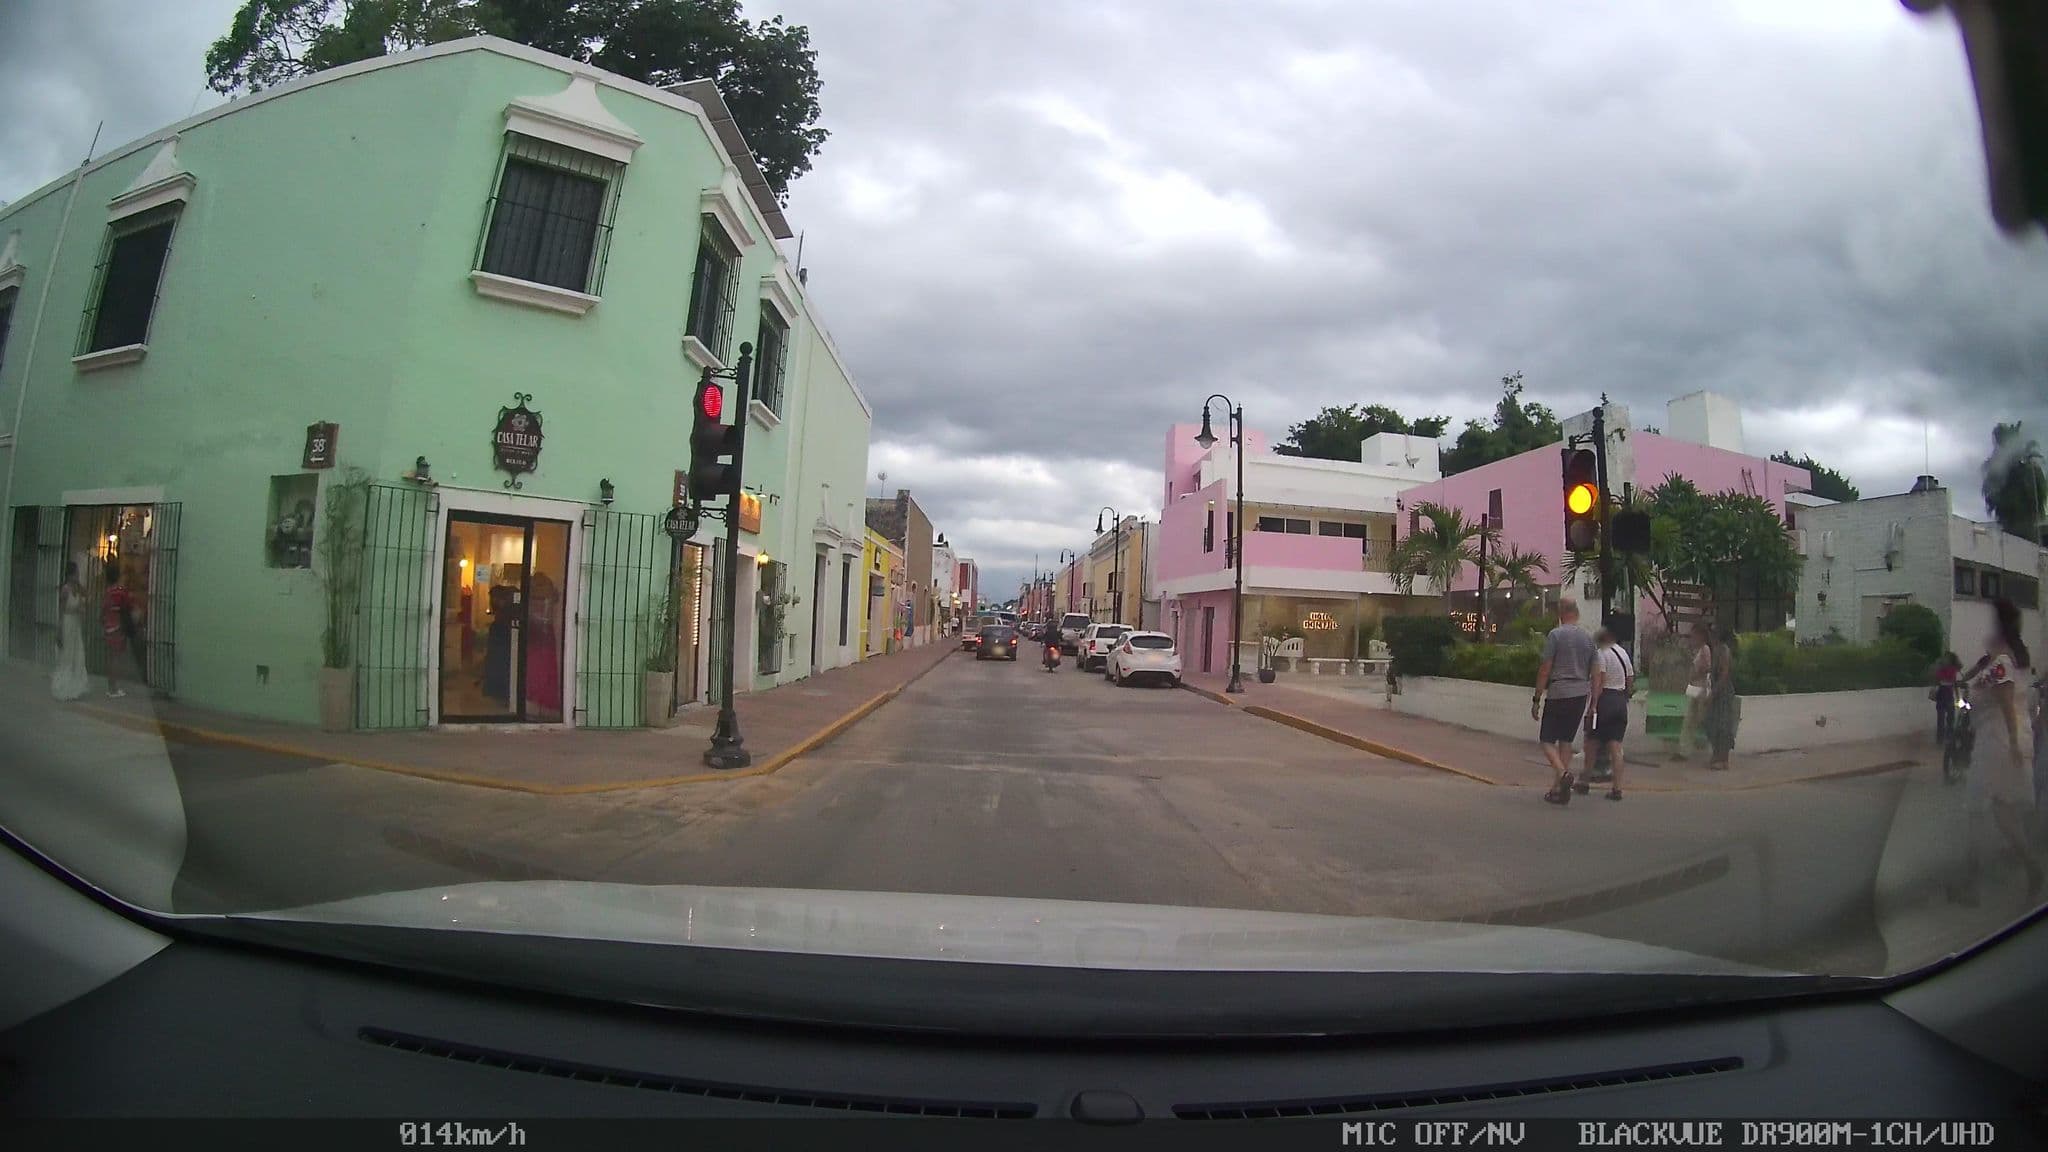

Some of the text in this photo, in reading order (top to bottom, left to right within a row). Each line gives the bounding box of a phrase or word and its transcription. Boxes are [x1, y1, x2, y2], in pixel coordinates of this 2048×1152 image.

[312, 438, 326, 453] 38
[497, 431, 538, 448] CASA TELAR
[666, 519, 679, 530] CASA
